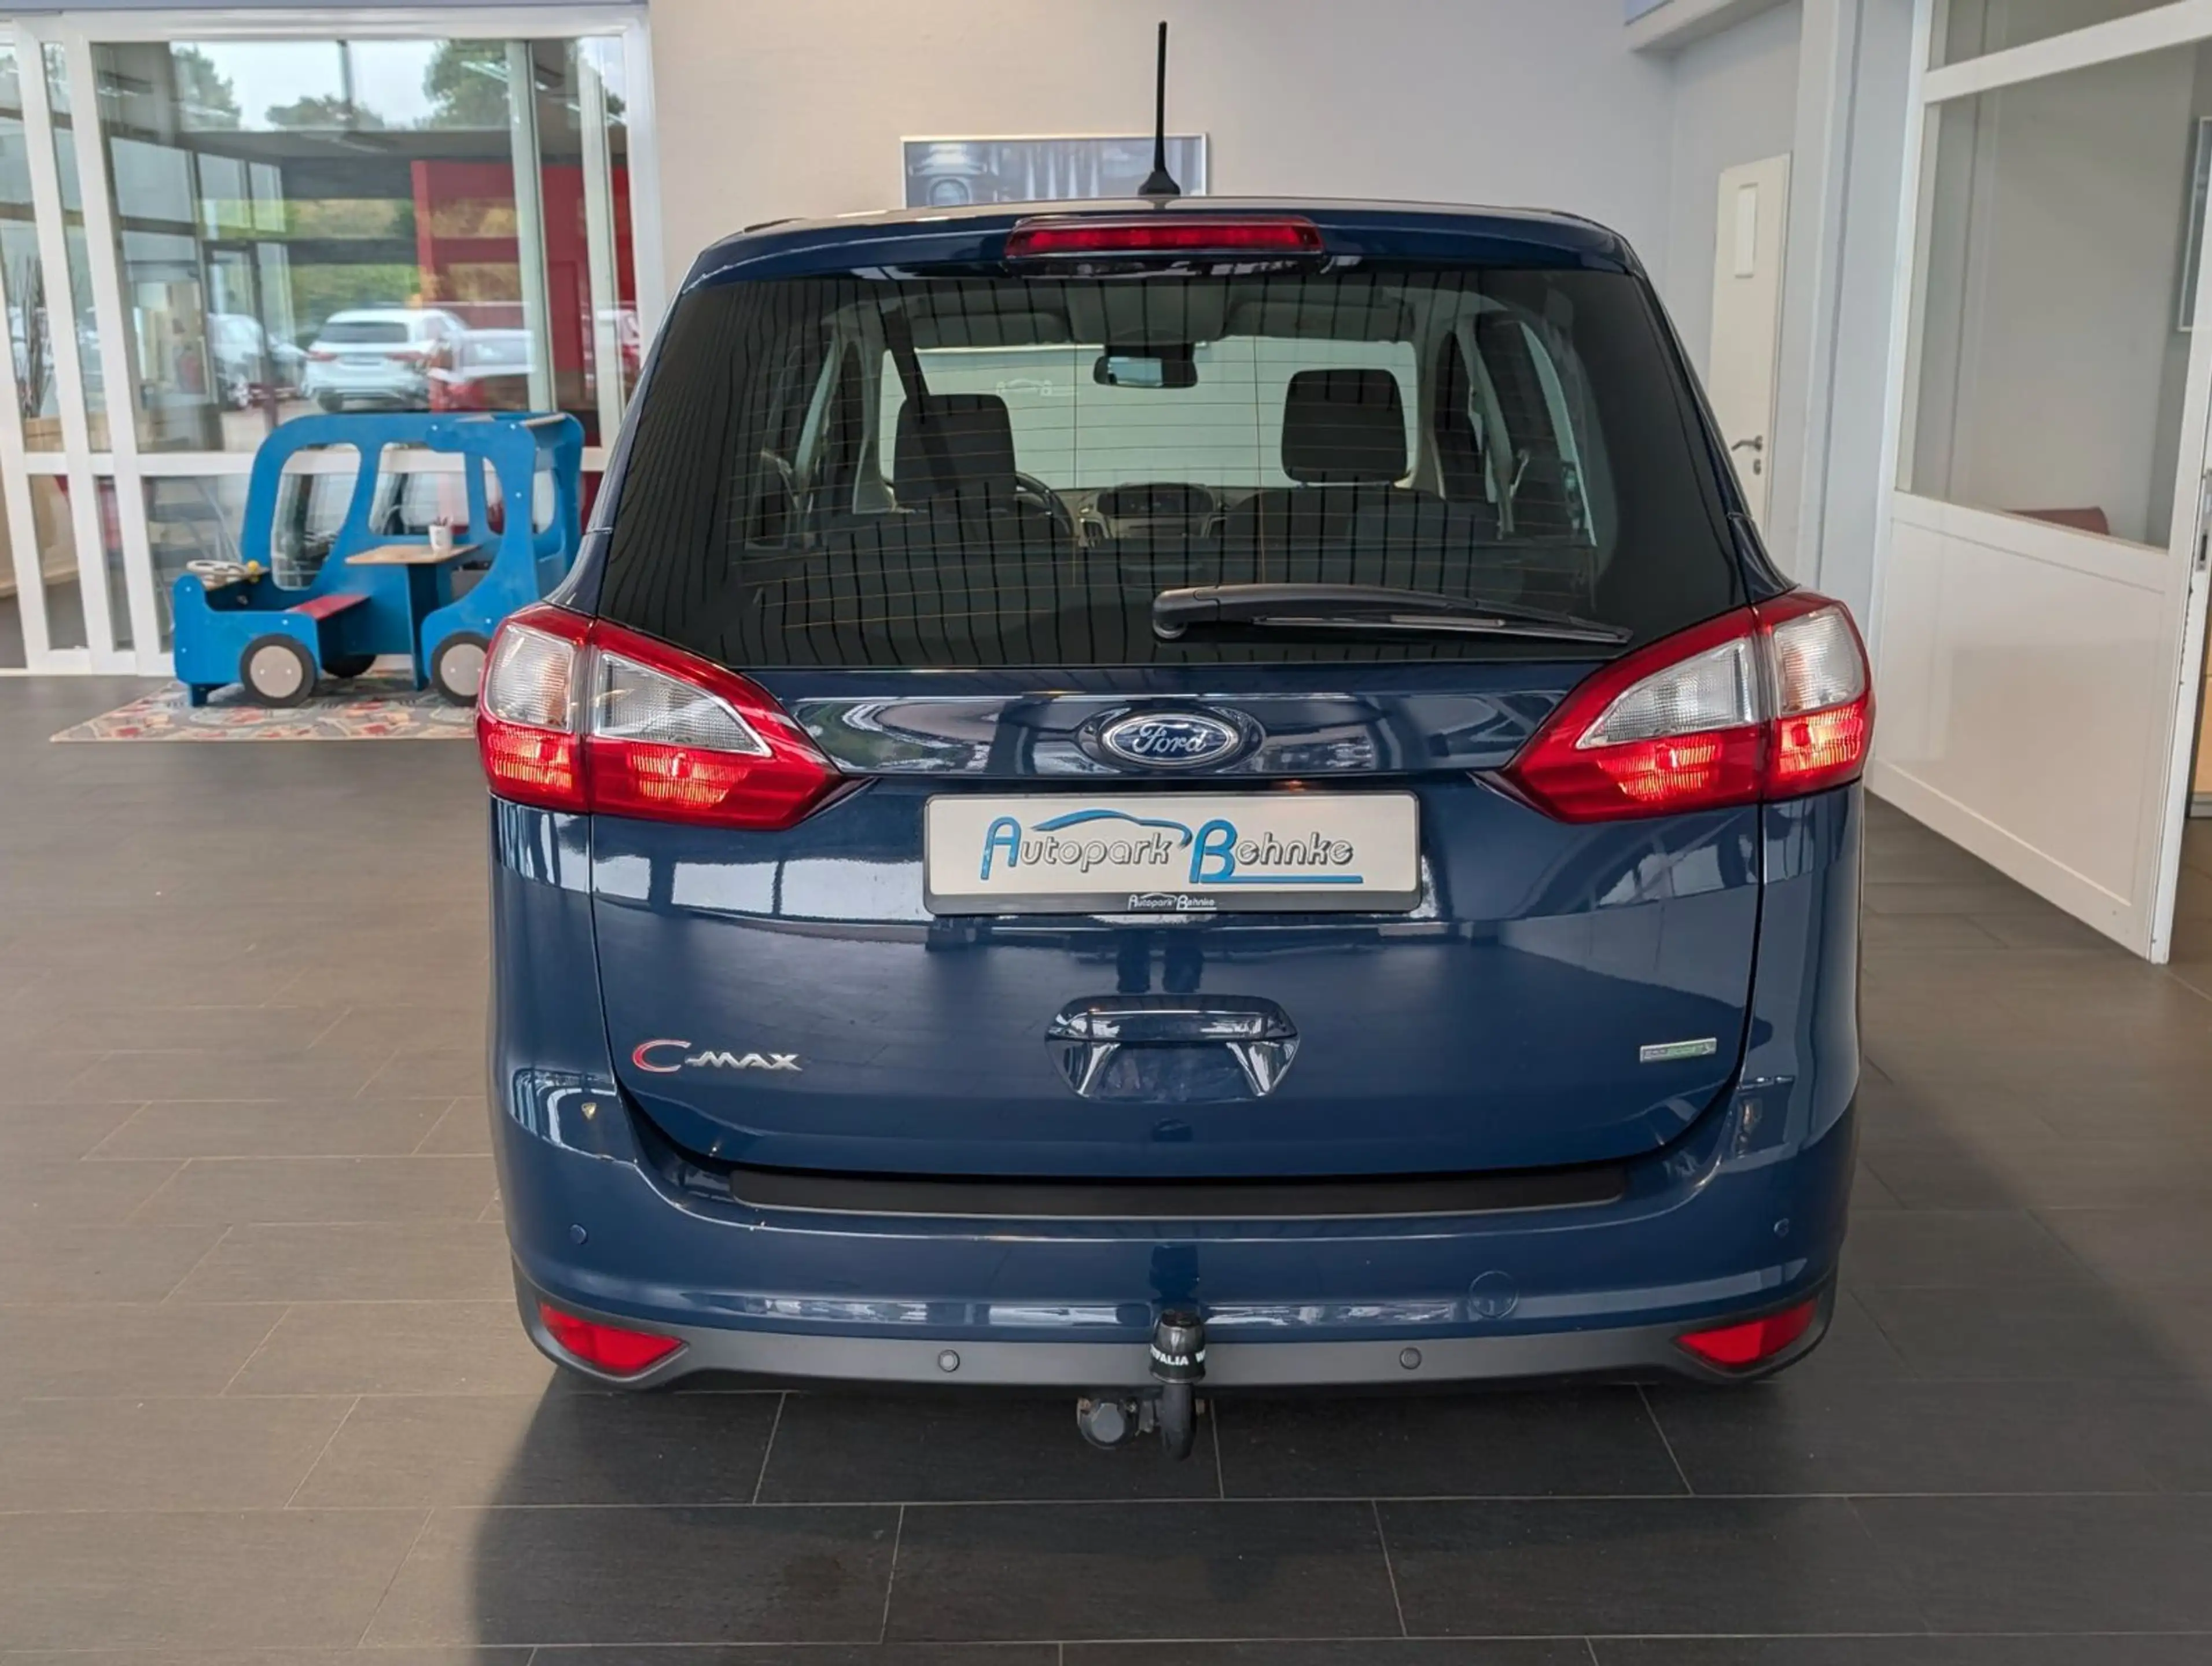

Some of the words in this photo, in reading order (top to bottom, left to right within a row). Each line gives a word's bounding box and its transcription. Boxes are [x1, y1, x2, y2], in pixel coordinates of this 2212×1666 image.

[1132, 723, 1207, 753] Ford
[981, 816, 1172, 880] Autopark
[1189, 819, 1354, 883] Behnke
[632, 1040, 803, 1071] C-MAX
